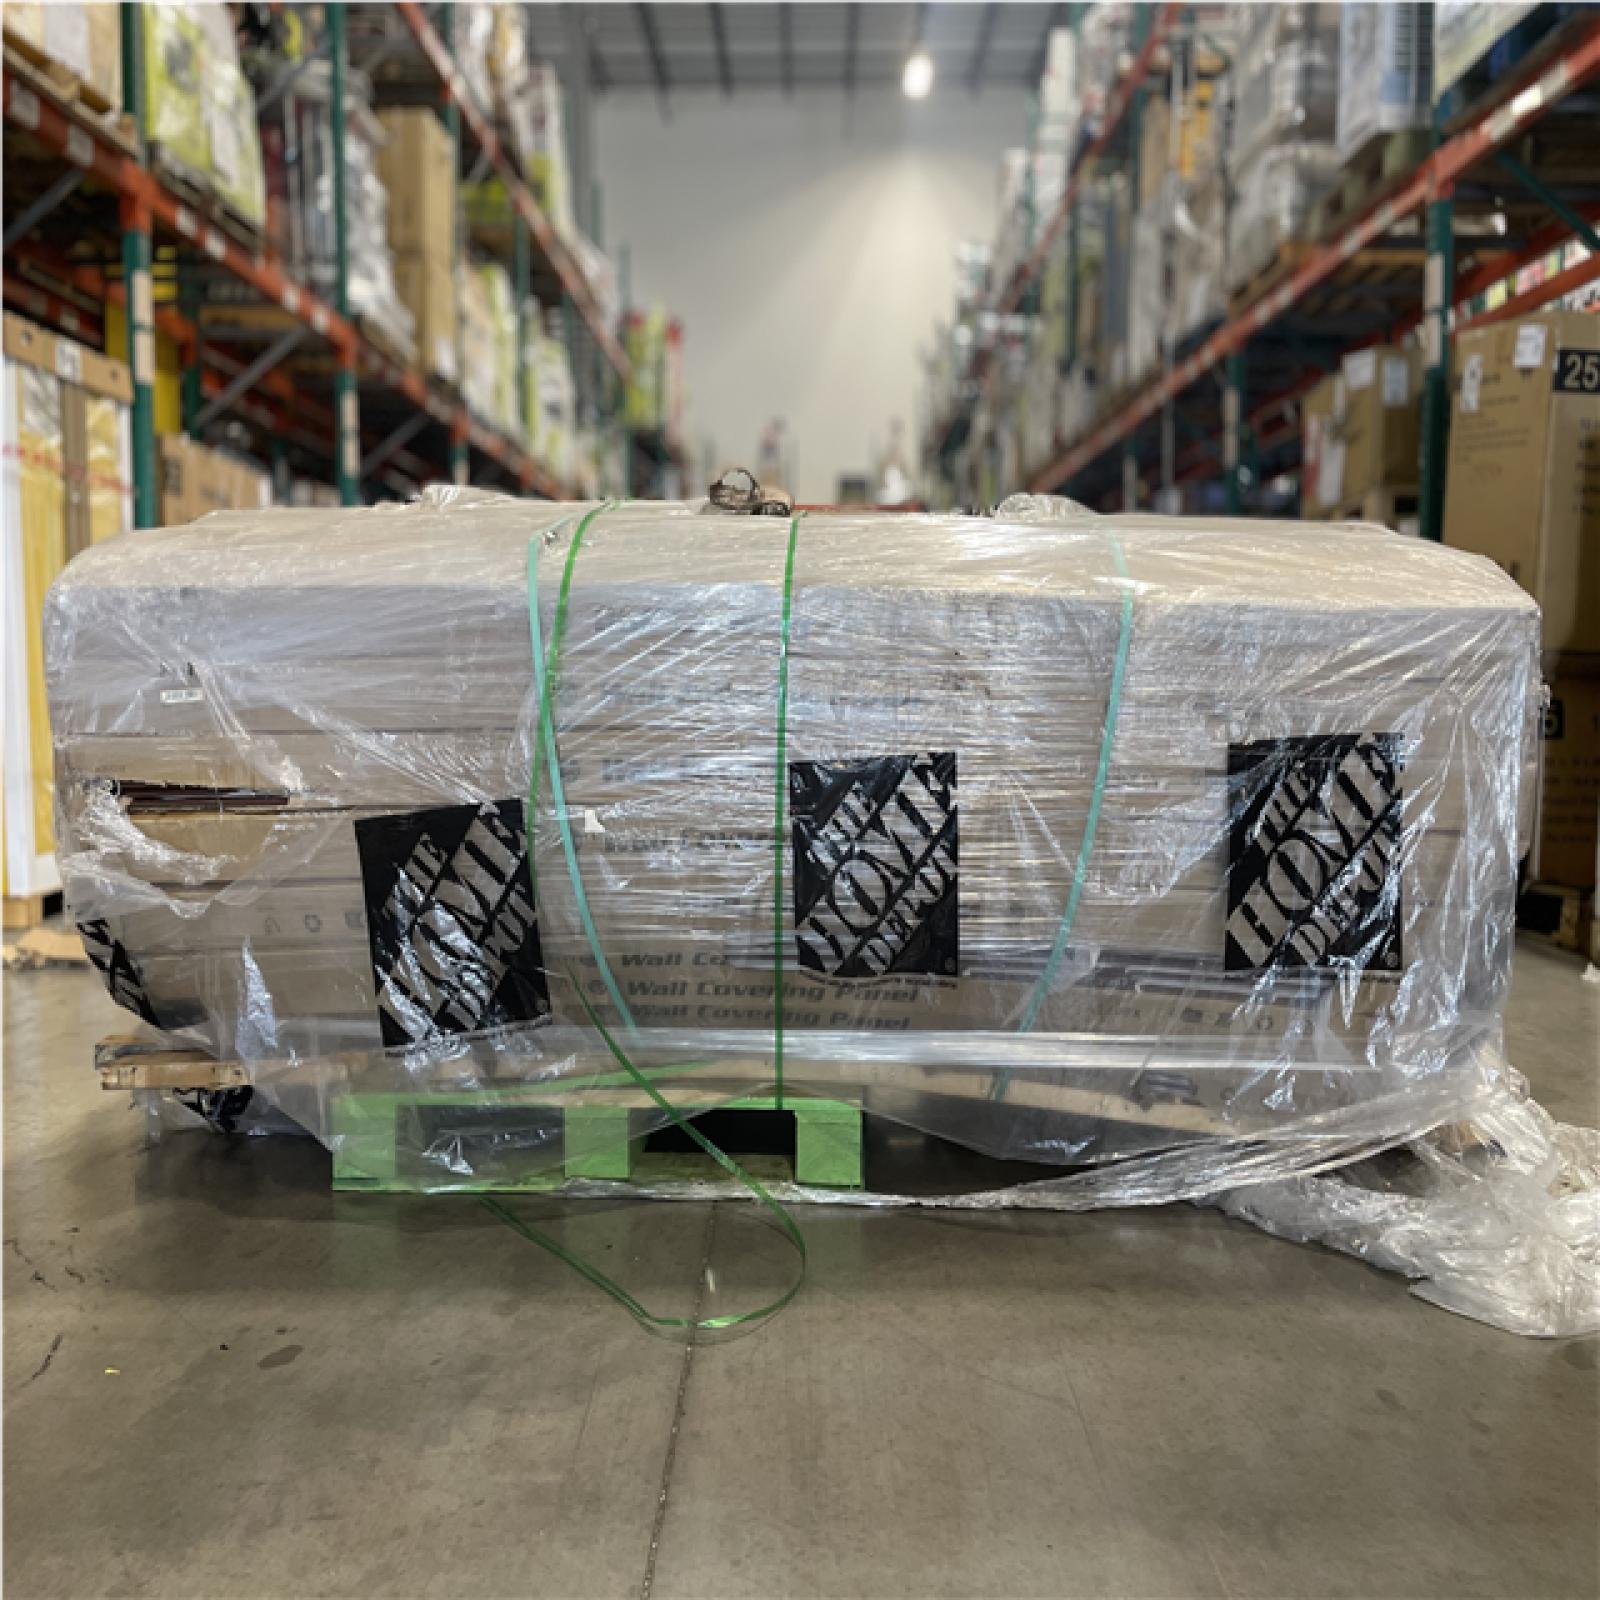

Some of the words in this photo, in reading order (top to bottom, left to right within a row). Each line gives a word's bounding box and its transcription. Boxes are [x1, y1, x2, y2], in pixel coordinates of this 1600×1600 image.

[1564, 354, 1600, 392] 25
[1255, 760, 1316, 856] THE
[795, 767, 959, 974] HOME
[1227, 747, 1401, 967] HOME
[376, 814, 531, 1042] HOME
[621, 952, 683, 966] Wall
[628, 981, 688, 996] Wall
[834, 985, 920, 1003] Panel
[630, 1004, 689, 1018] Wall
[697, 1004, 822, 1026] Coverng
